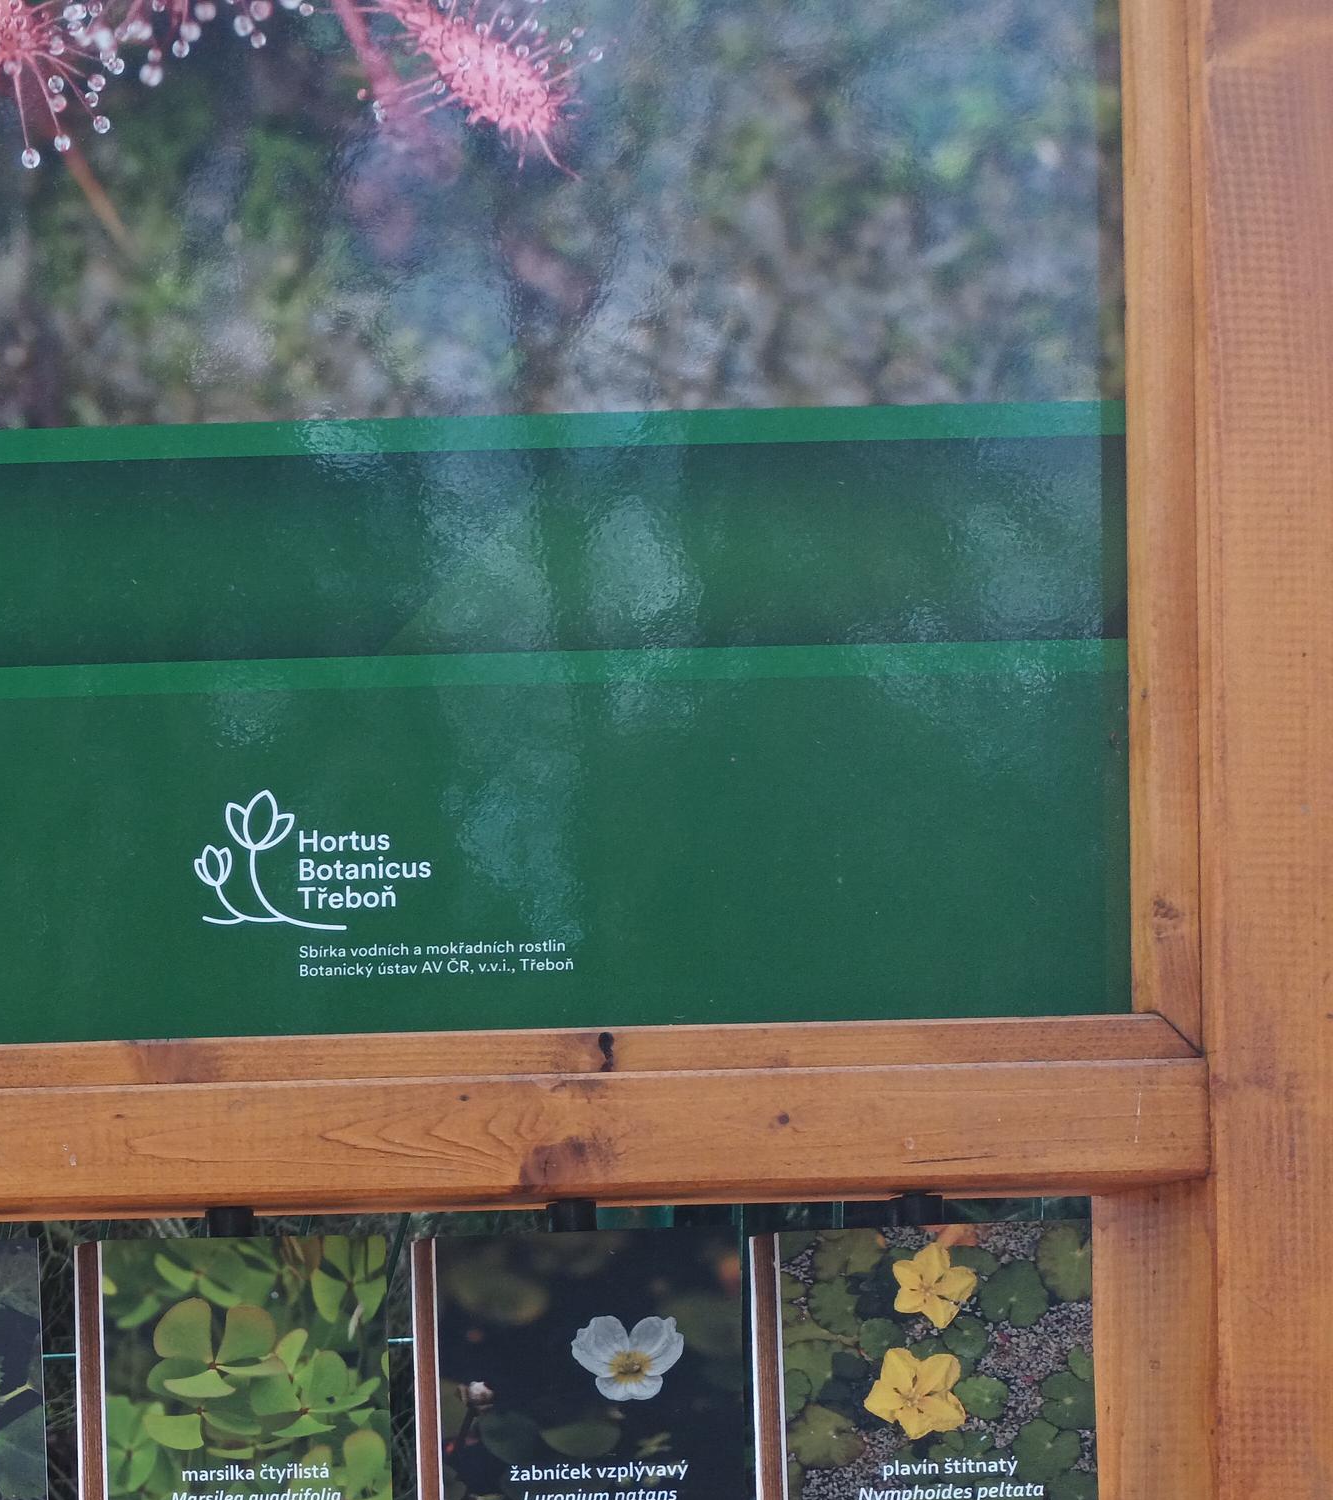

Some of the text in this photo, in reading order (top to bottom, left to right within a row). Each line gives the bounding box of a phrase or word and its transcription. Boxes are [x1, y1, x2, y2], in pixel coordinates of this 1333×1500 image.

[299, 830, 390, 852] Hortus
[299, 856, 431, 881] Botanicus
[297, 885, 397, 909] Třeboň
[299, 940, 565, 958] Sbírka vodních a mokřadních rostlin
[299, 958, 573, 978] Botanický ústav AV ČR, v.v.i., Třeboň
[182, 1462, 329, 1483] marsilka čtyřlistá
[510, 1460, 688, 1482] žabníček vzplývavý
[883, 1456, 1018, 1480] plavín štítnatý
